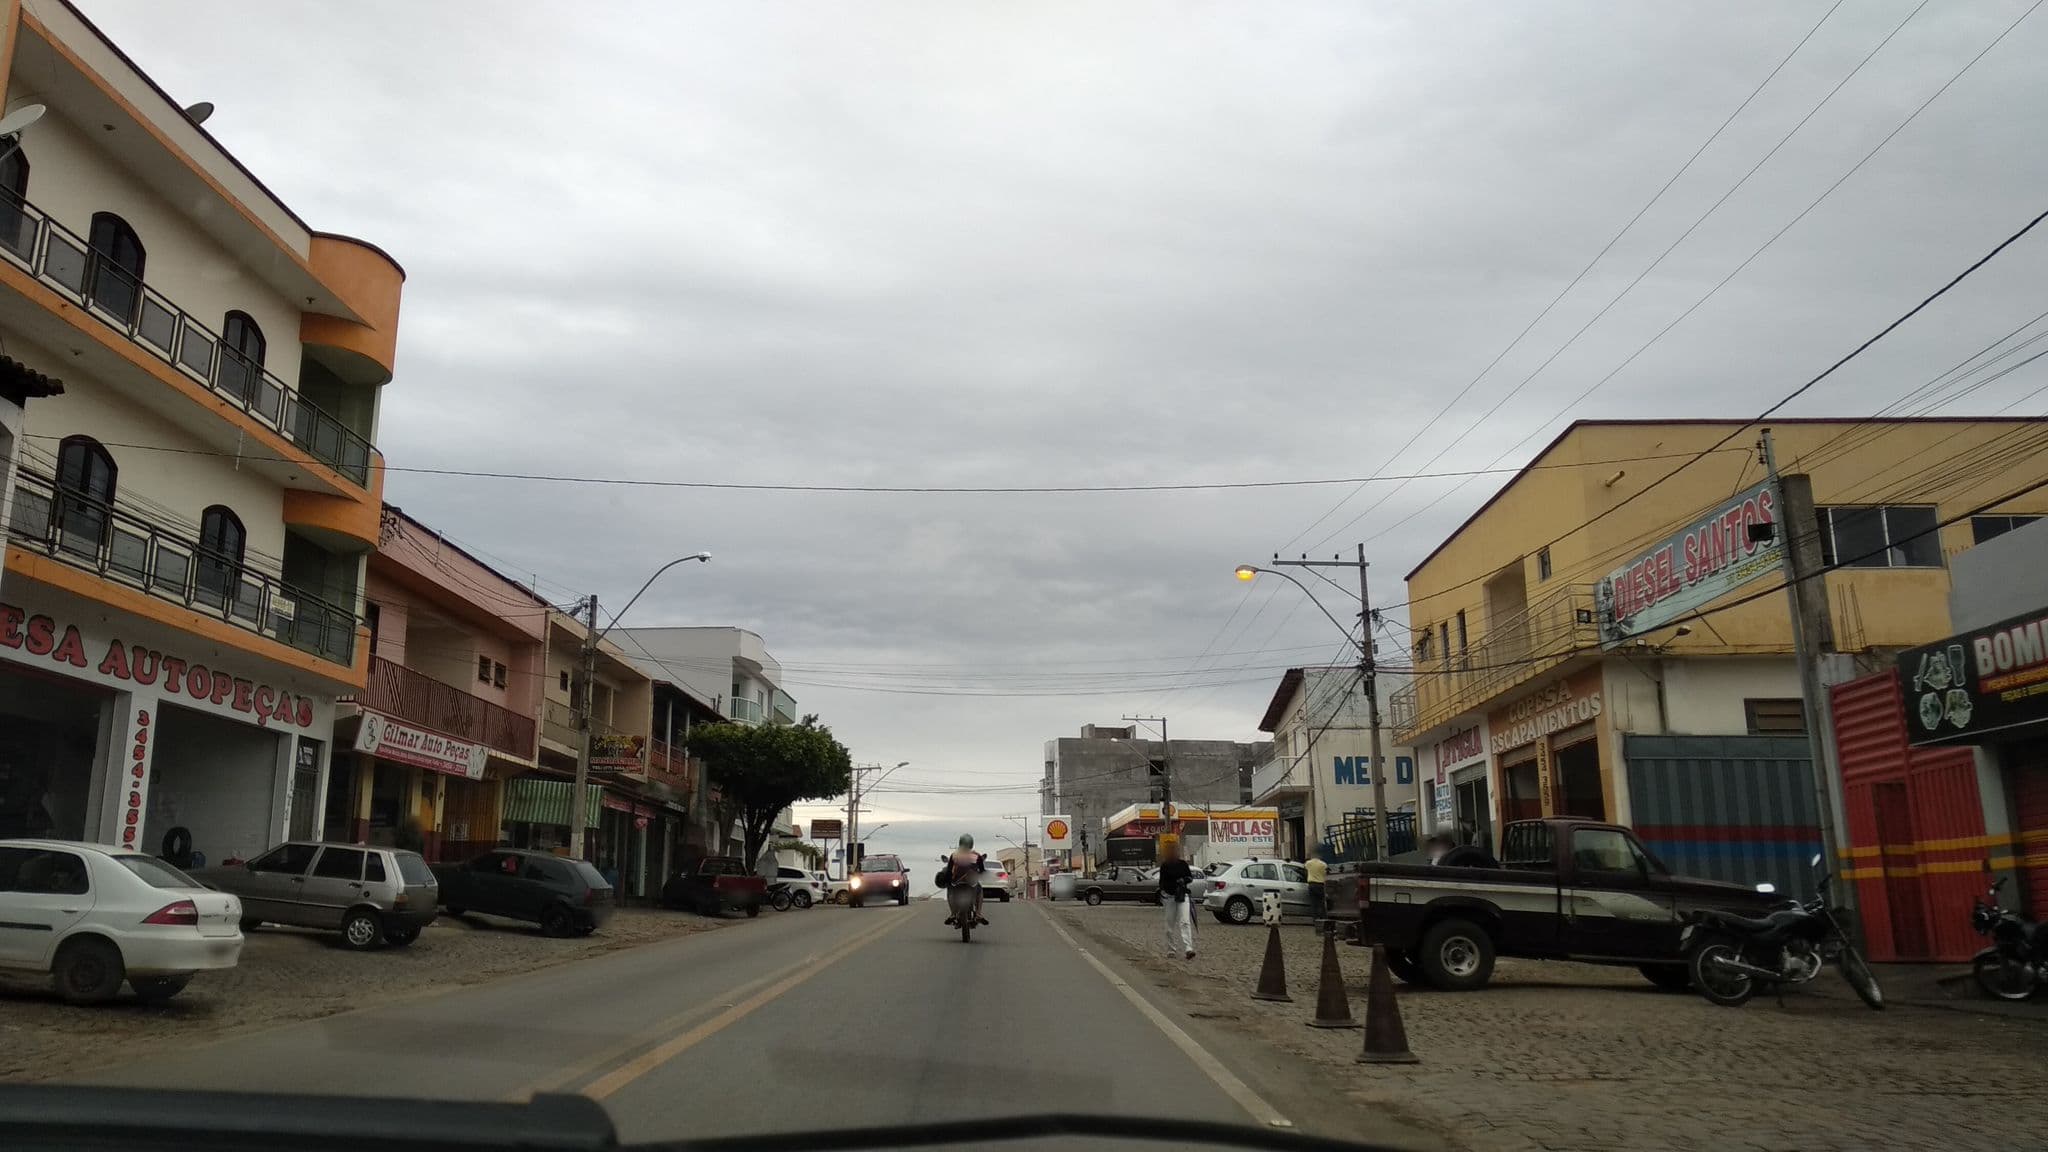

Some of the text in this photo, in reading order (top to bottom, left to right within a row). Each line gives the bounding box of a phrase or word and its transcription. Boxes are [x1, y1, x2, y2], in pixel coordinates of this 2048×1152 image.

[1614, 543, 1682, 622] DIESEL
[1683, 488, 1774, 585] SANTOS
[98, 639, 314, 727] AUTOPEÇAS
[383, 724, 420, 748] Gilmar
[421, 734, 442, 754] Auto
[1491, 691, 1602, 754] ESCAPAMENTOS
[1211, 820, 1273, 842] MOLAS
